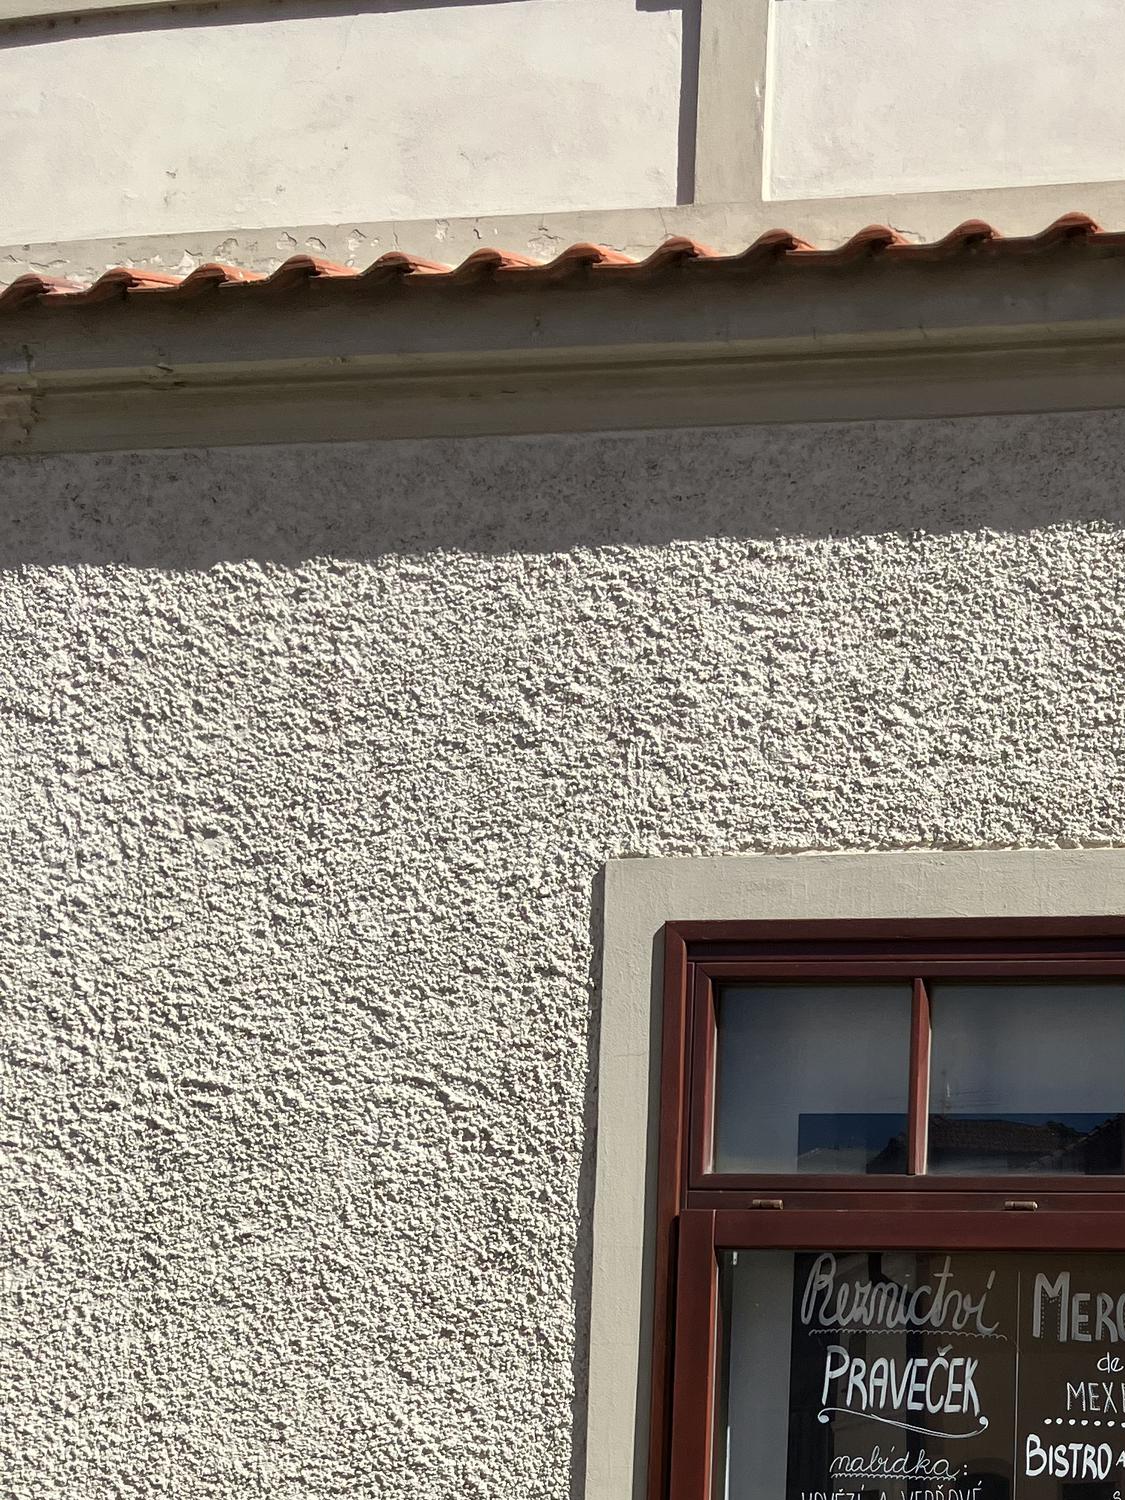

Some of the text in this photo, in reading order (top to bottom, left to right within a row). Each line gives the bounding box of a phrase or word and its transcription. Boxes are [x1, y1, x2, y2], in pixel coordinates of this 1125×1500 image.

[821, 1344, 981, 1416] PRAVEČEK
[1097, 1352, 1124, 1373] de
[1025, 1434, 1112, 1480] BISTRO
